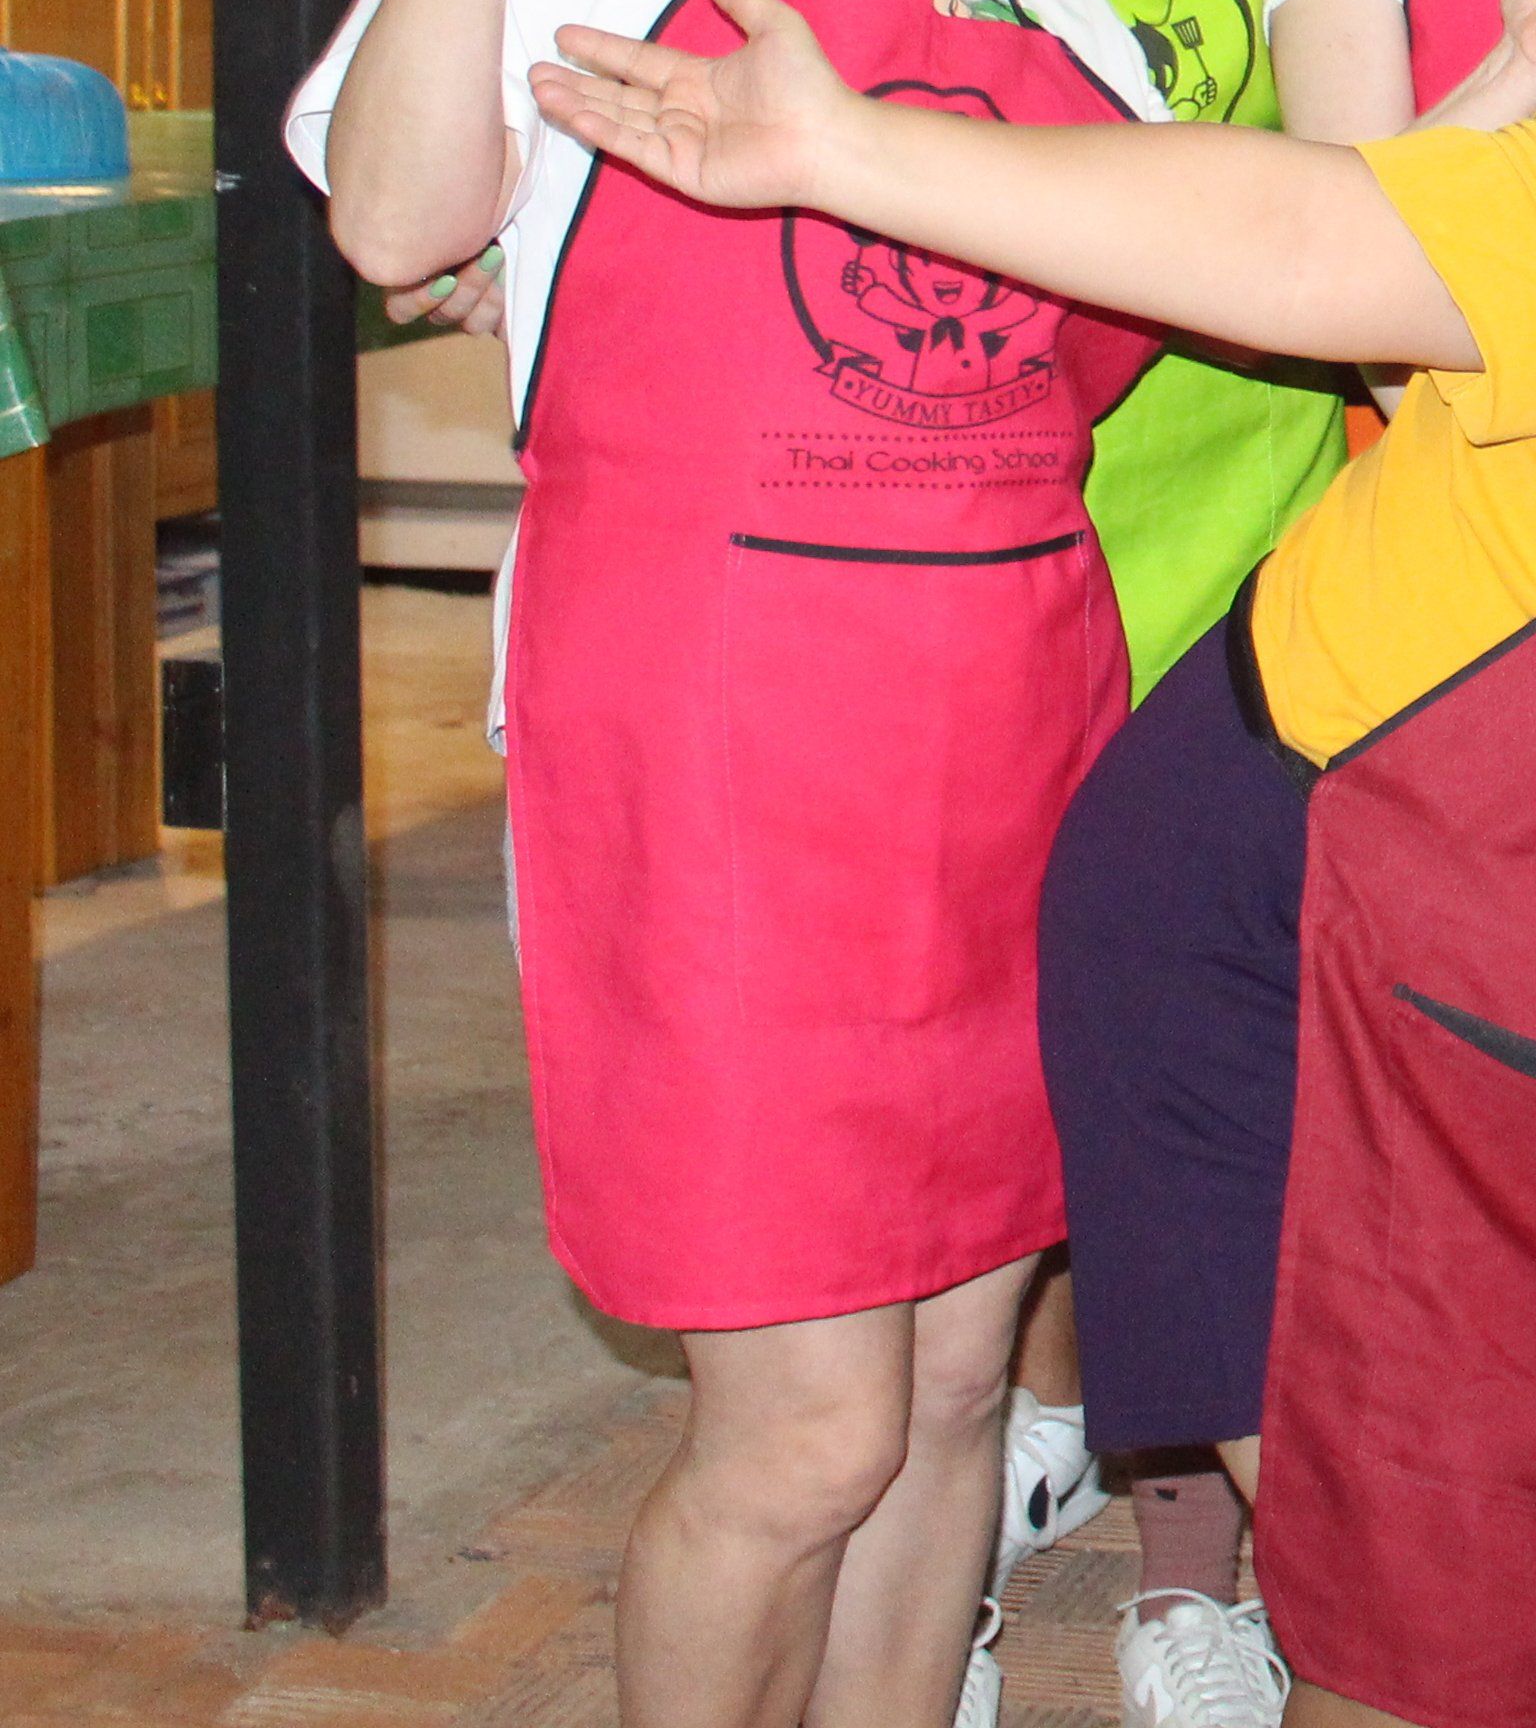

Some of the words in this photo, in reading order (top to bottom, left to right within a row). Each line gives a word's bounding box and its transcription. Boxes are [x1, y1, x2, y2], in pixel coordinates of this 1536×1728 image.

[856, 380, 953, 424] YUMMY
[965, 382, 1034, 421] TASTY
[787, 448, 853, 470] Thai
[866, 451, 985, 474] Cooking
[992, 448, 1059, 469] School
